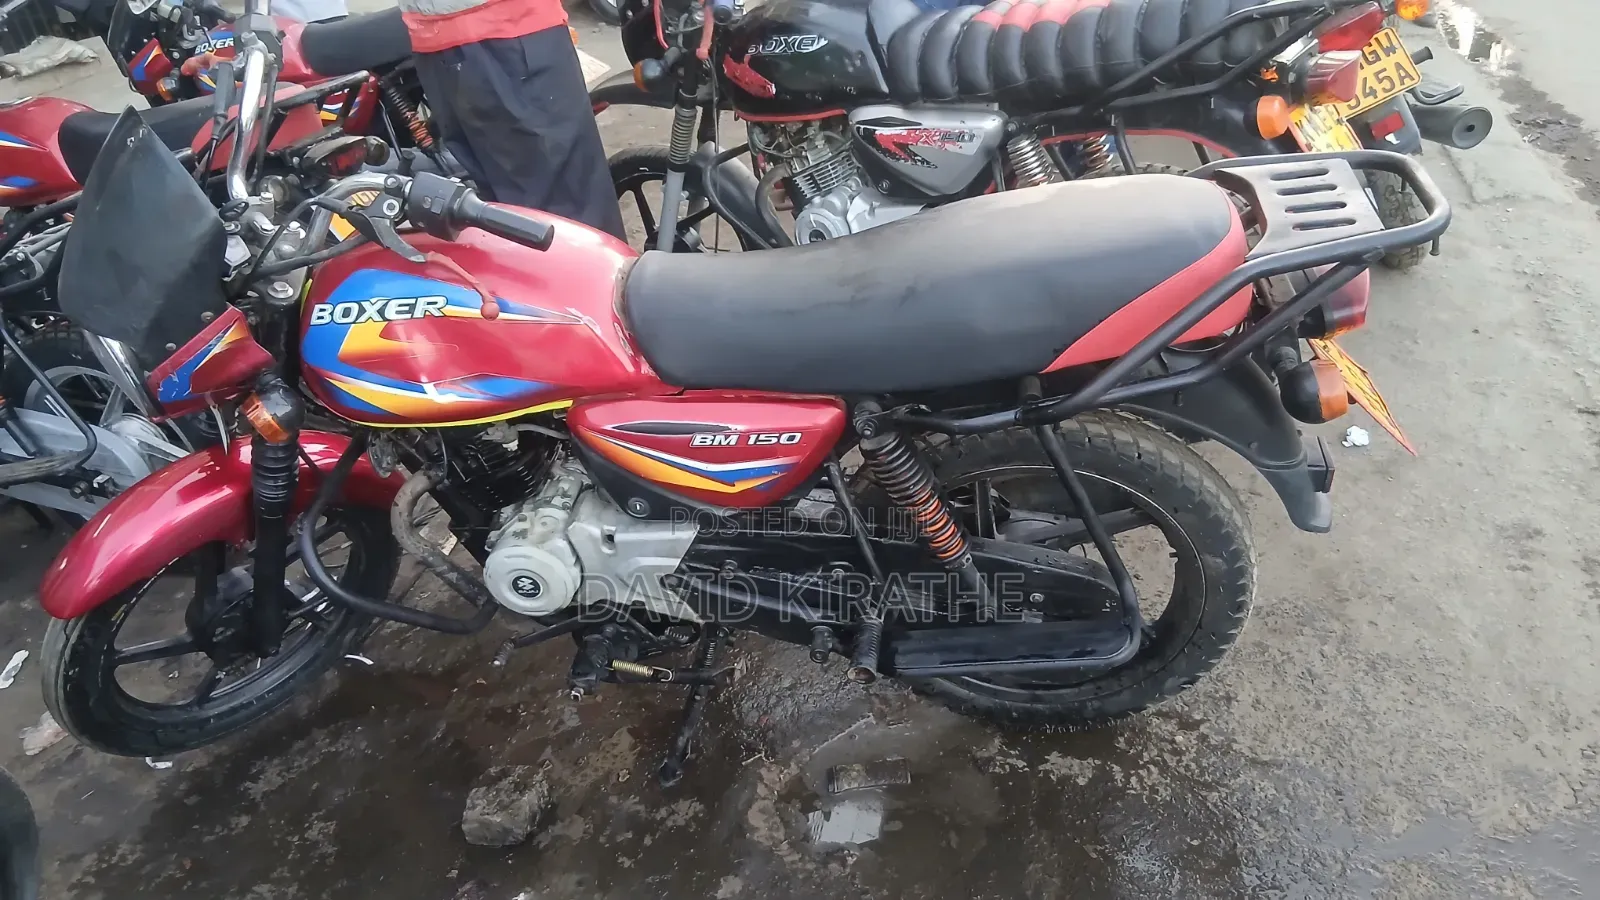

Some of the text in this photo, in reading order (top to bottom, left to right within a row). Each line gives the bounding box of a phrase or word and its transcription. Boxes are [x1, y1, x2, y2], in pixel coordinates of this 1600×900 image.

[1359, 31, 1398, 70] GW
[309, 295, 448, 326] BOXER
[690, 432, 803, 447] BM 150
